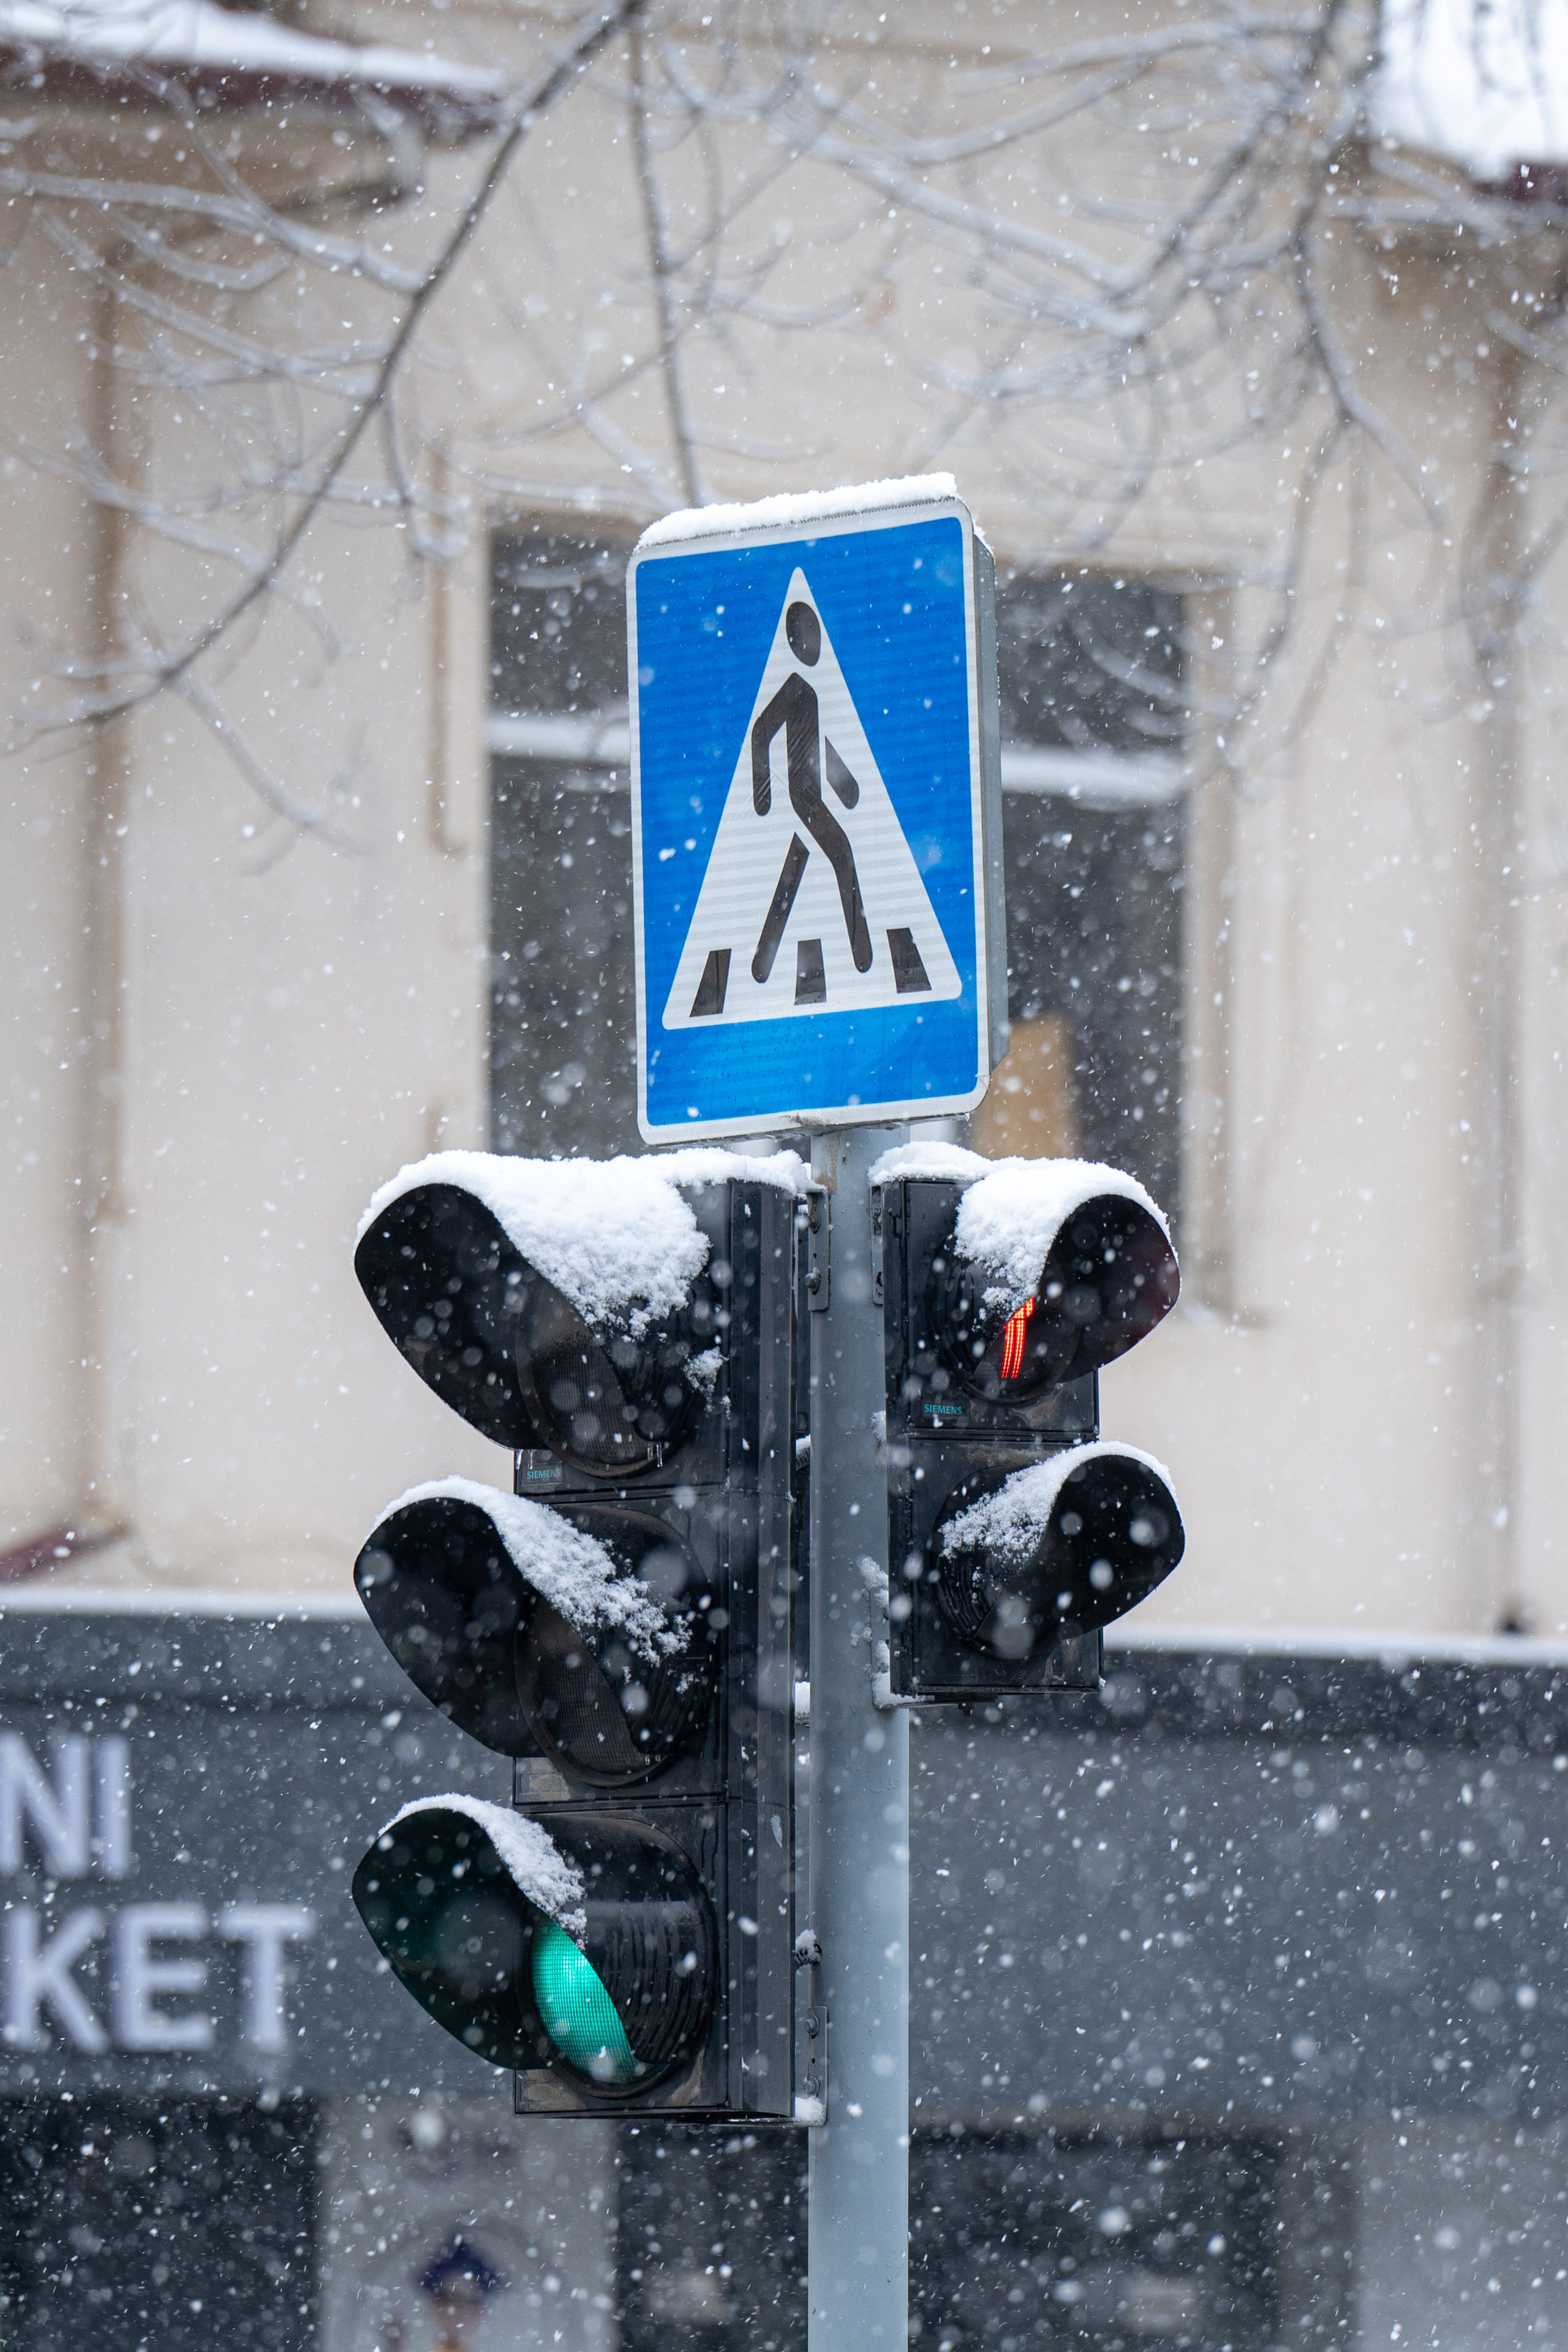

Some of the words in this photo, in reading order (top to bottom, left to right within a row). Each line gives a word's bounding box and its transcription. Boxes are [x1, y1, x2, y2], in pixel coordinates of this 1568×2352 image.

[924, 1403, 963, 1415] SIEMENS
[527, 1469, 561, 1479] SIEMENS
[4, 1904, 314, 2052] KET
